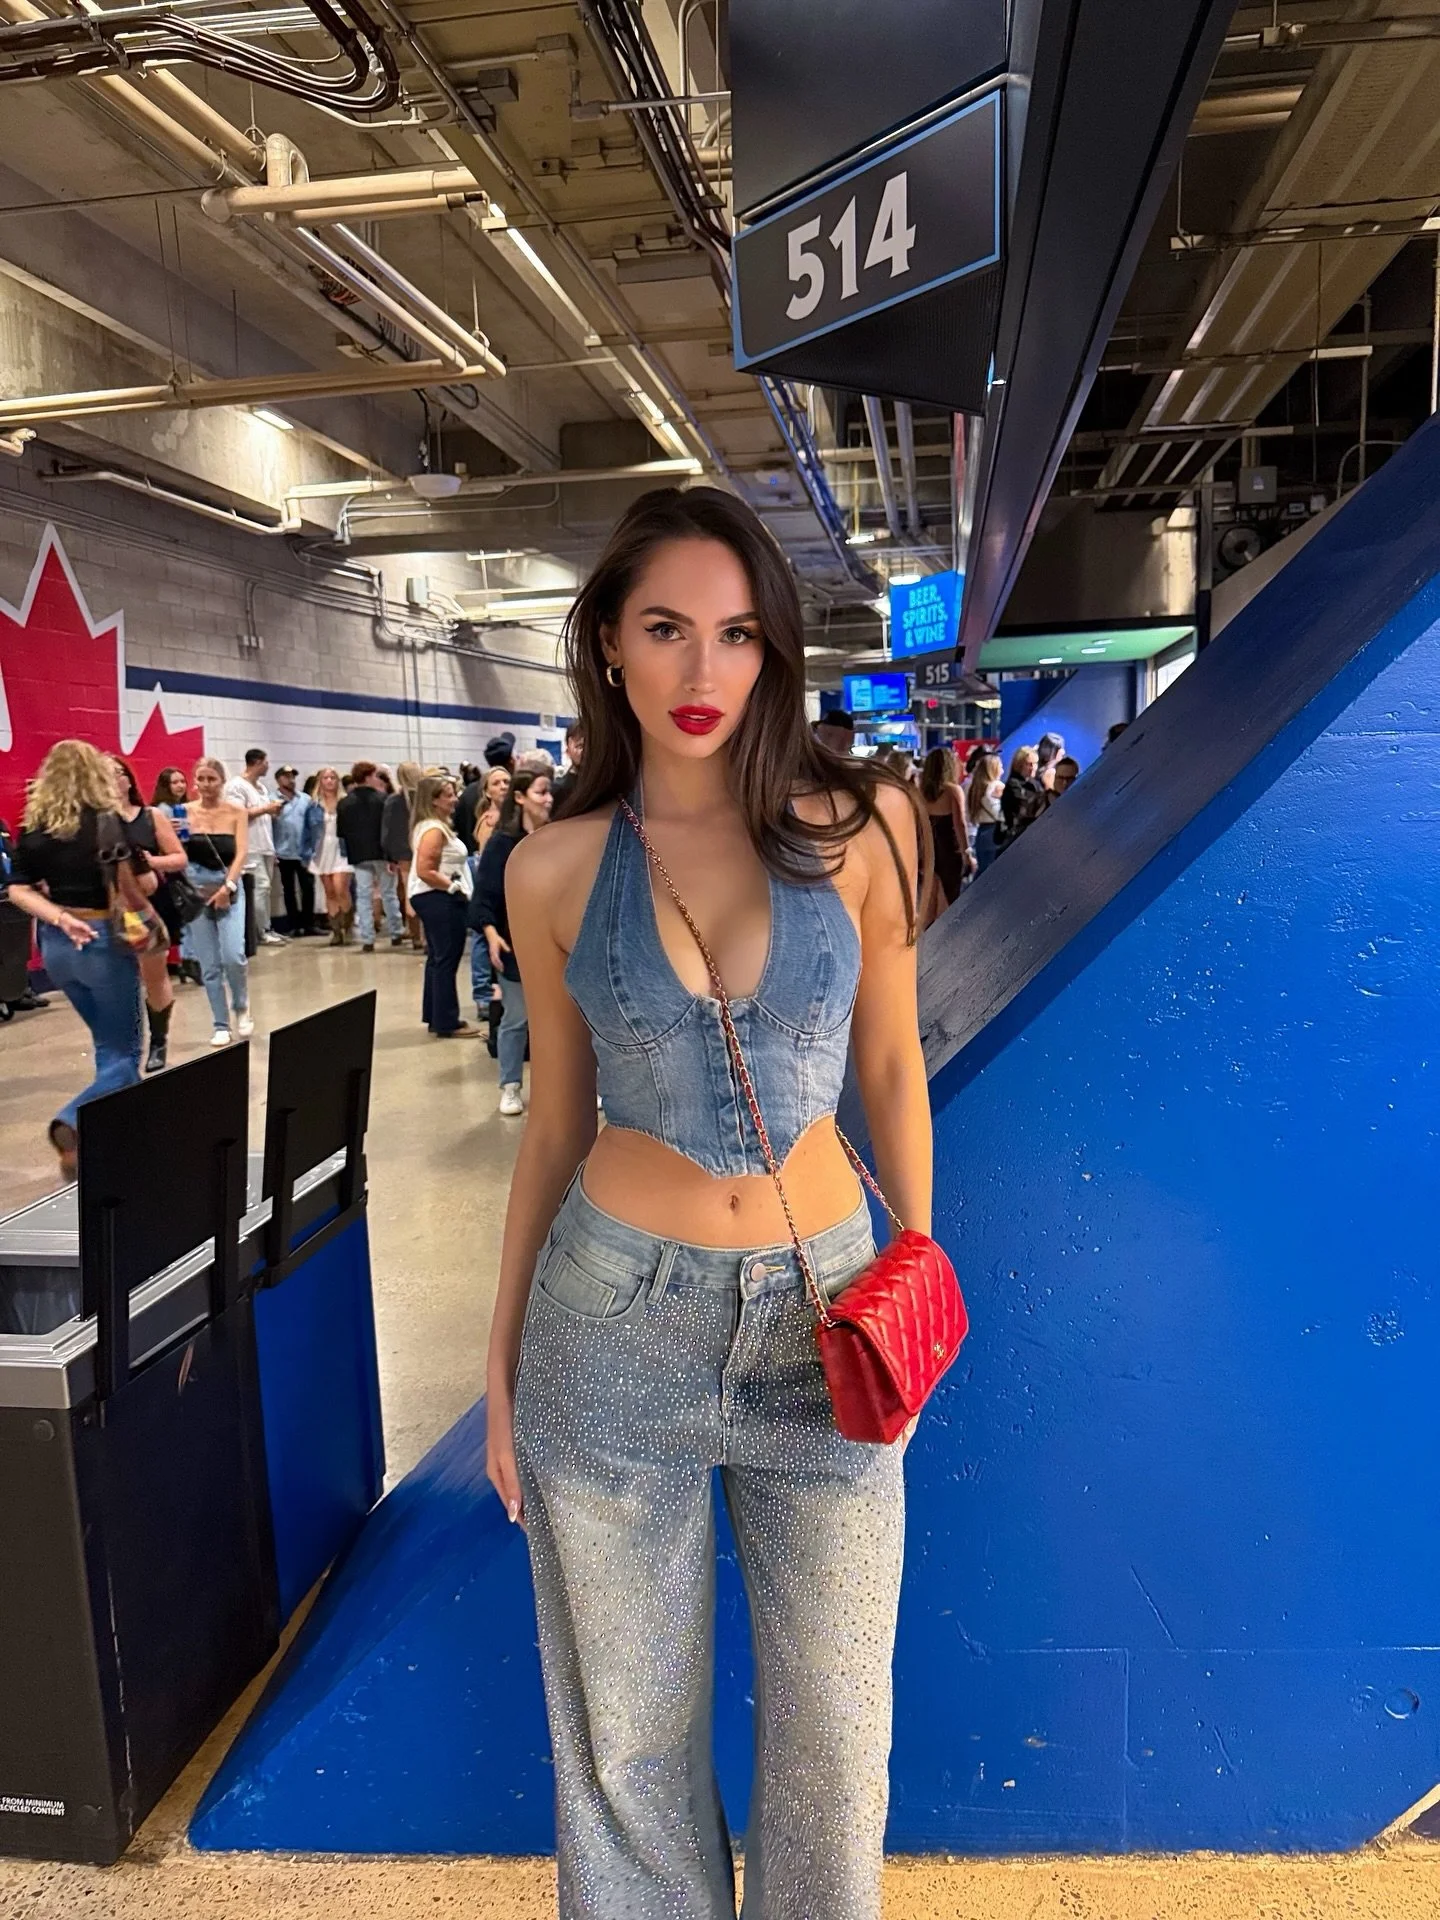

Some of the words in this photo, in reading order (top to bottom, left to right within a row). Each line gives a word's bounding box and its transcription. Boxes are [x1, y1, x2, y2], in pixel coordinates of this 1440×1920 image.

[785, 170, 917, 321] 514
[904, 629, 914, 648] &
[914, 621, 945, 645] WINE
[925, 662, 950, 685] 515
[0, 1804, 30, 1813] ECYCLED
[31, 1806, 65, 1816] CONTENT
[2, 1796, 24, 1806] FROM
[25, 1799, 65, 1809] MINIMUM
